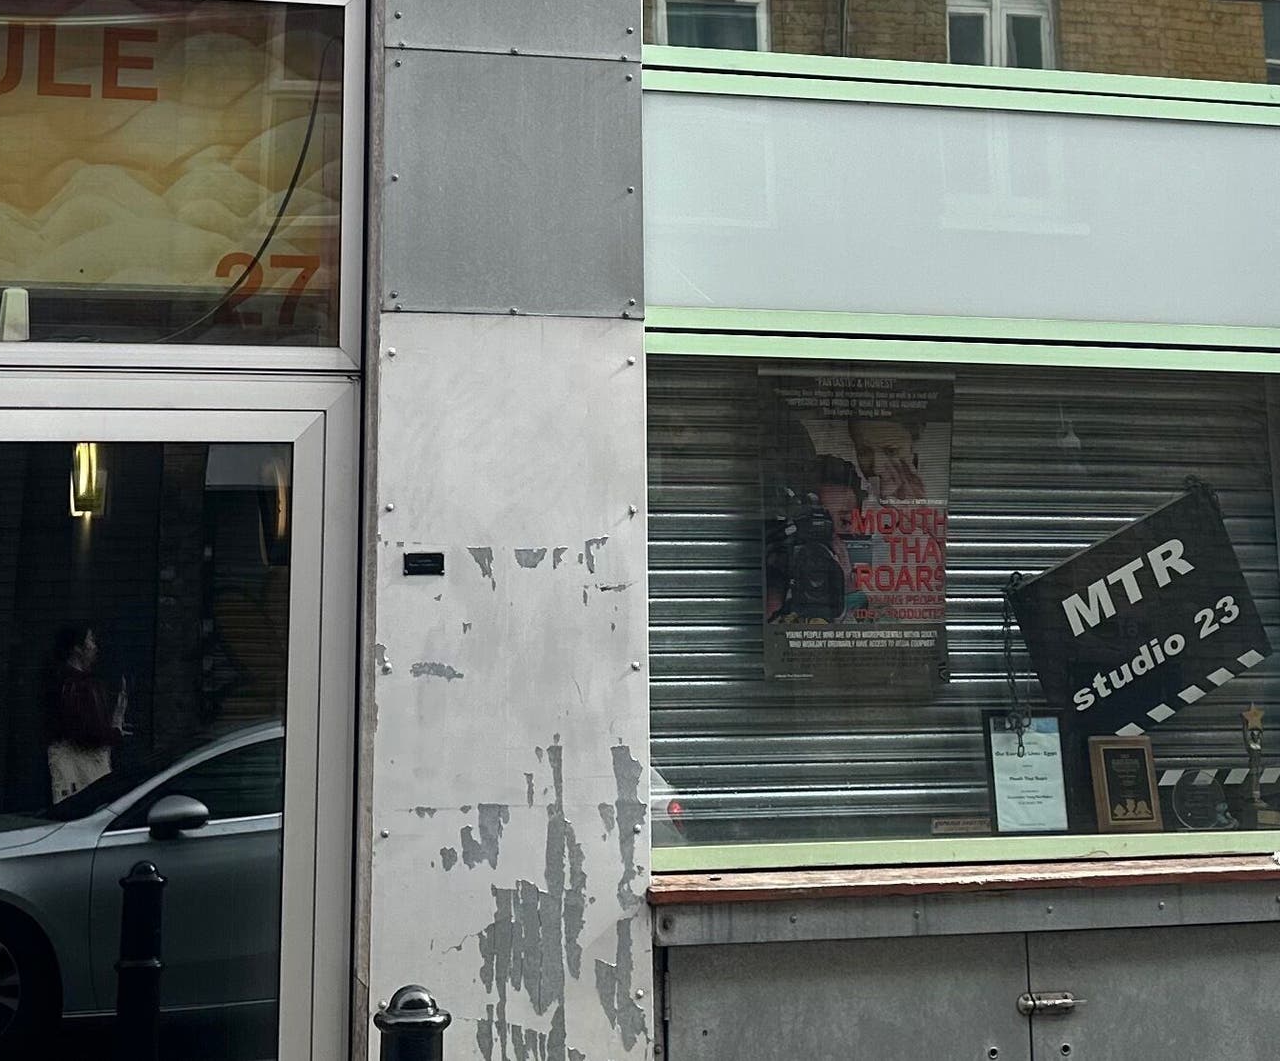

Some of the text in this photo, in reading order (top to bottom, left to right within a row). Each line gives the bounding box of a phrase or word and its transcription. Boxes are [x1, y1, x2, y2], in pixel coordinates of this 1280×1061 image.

[215, 253, 322, 327] 27
[851, 506, 948, 534] MOUTH
[1061, 539, 1195, 637] MTR
[1073, 595, 1241, 712] studio 23
